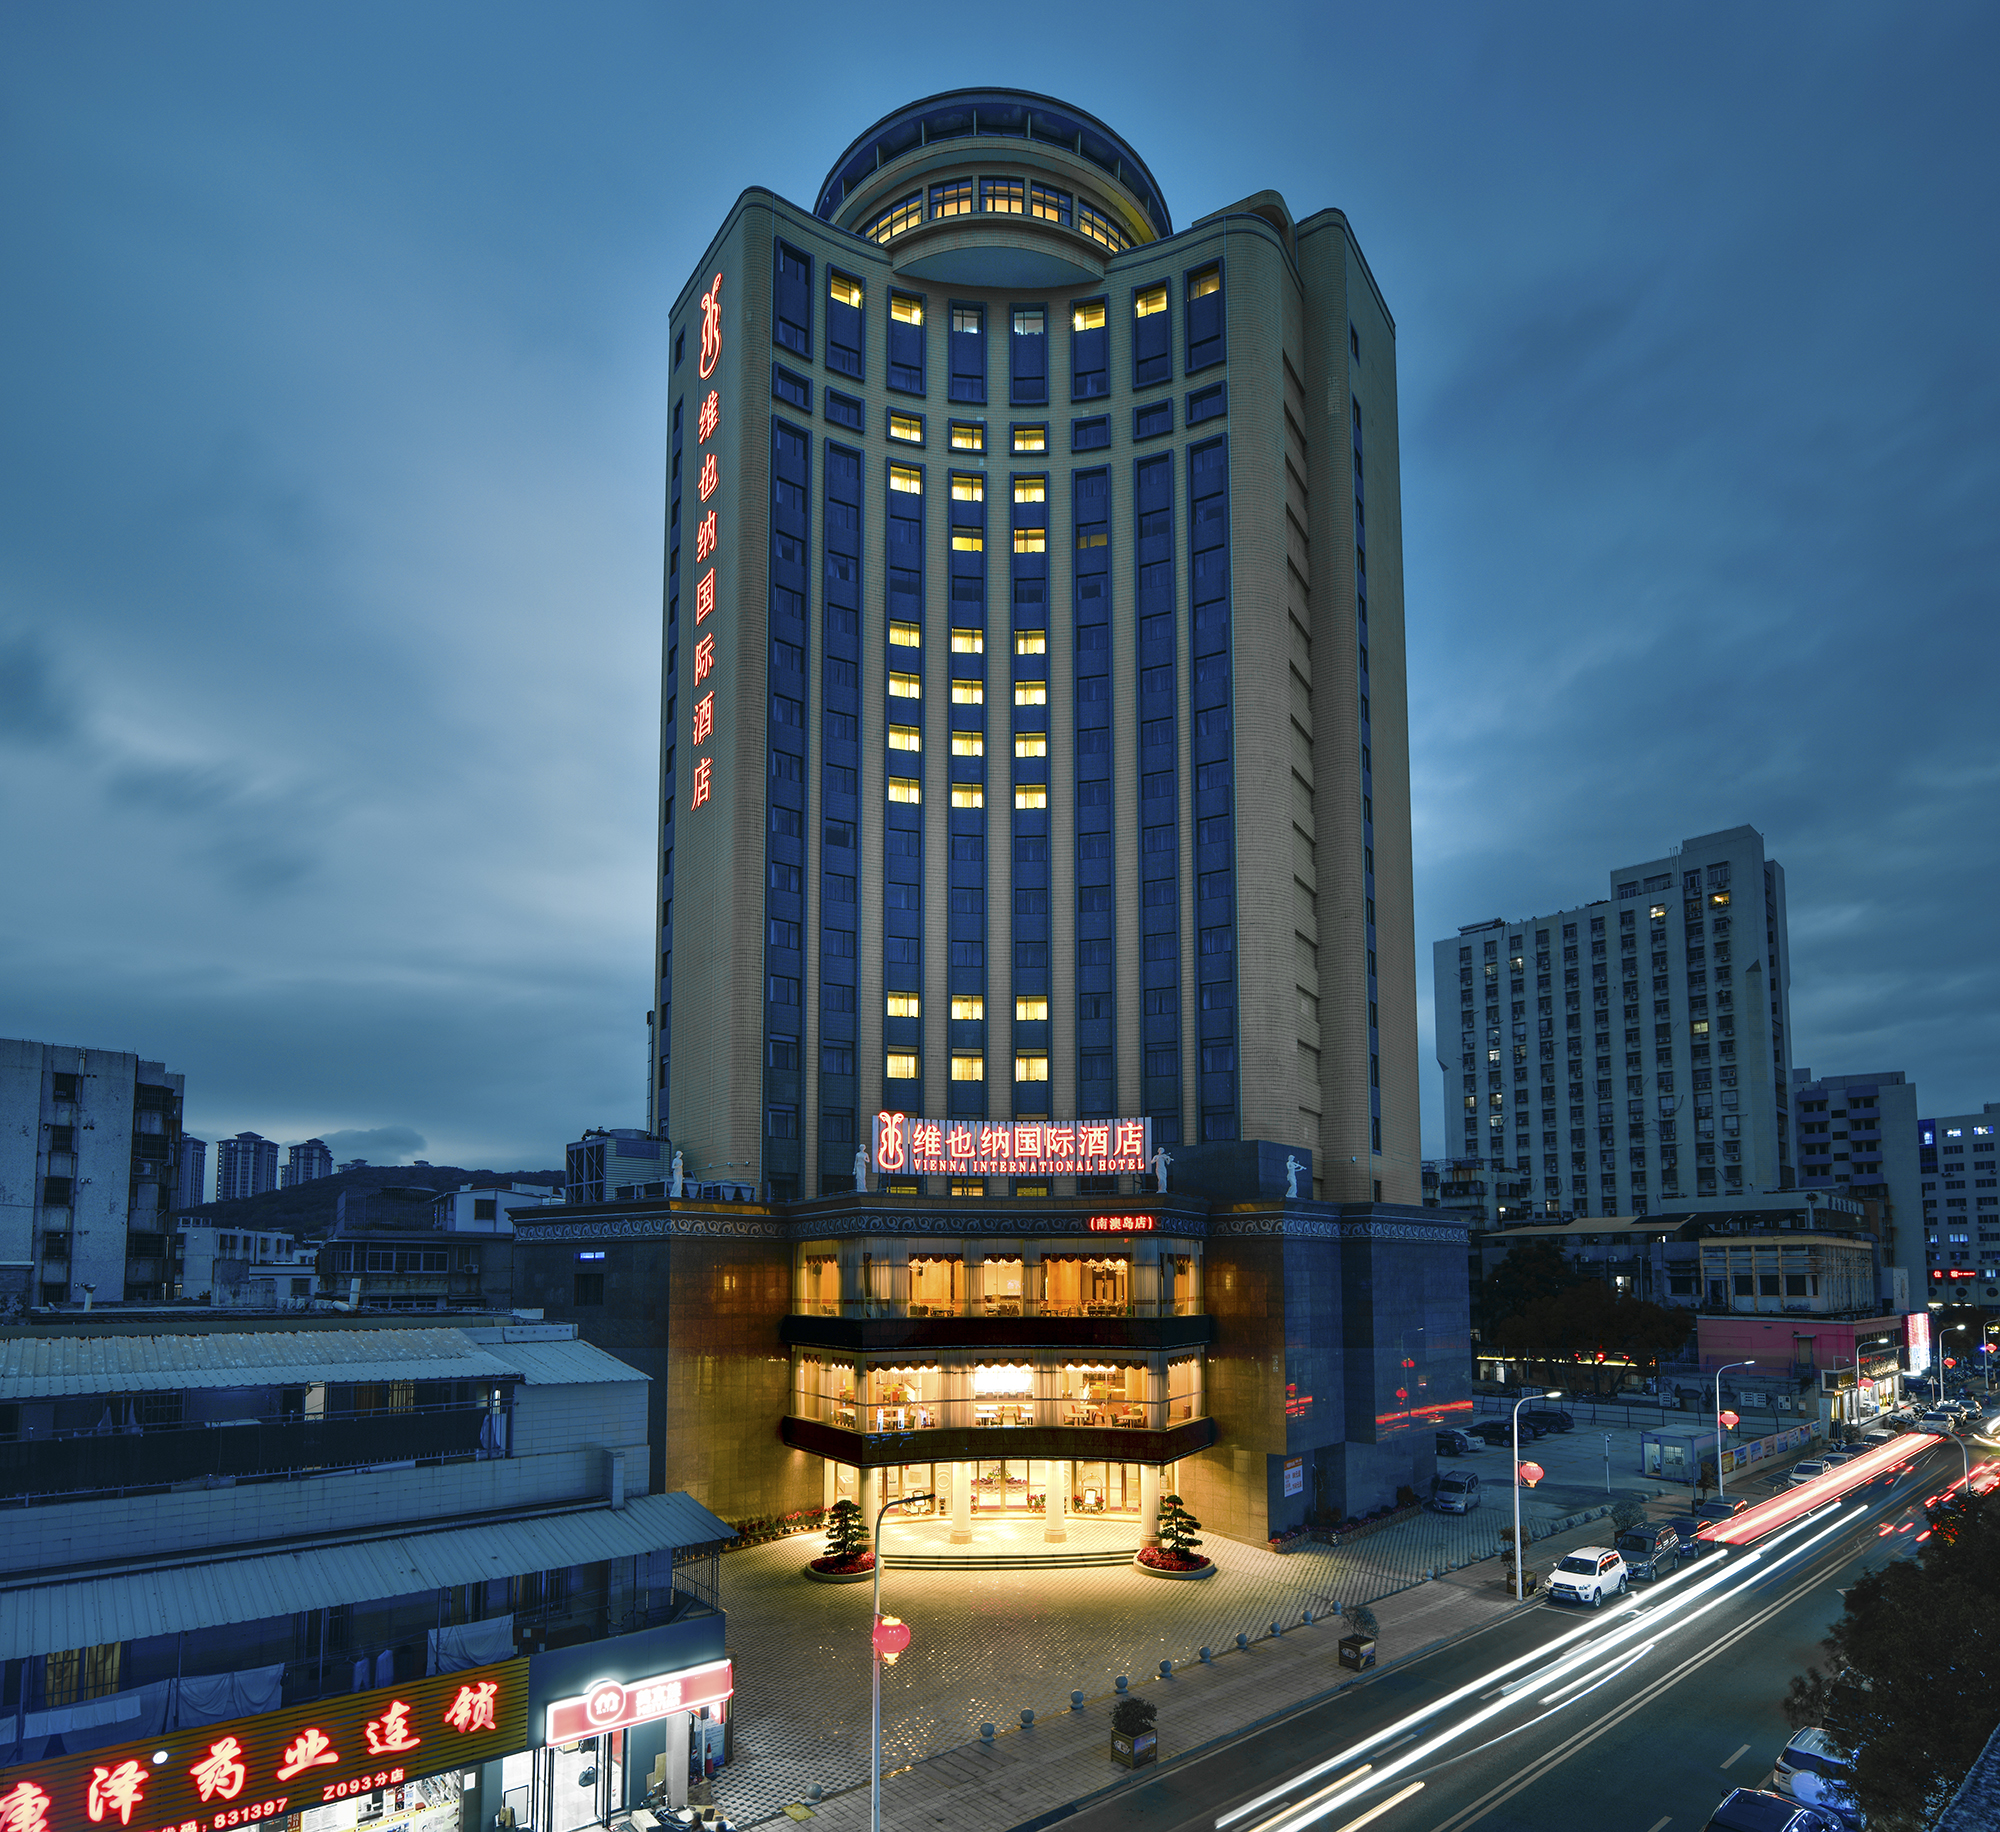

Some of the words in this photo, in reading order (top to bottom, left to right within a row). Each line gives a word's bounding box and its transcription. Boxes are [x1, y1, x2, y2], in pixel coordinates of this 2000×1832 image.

[691, 388, 721, 812] 维也纳国际酒店
[912, 1121, 1144, 1160] 维也纳国际酒店
[913, 1158, 967, 1173] VIENNA
[972, 1159, 1094, 1173] INTERNATIONAL
[1097, 1157, 1145, 1172] HOTEL
